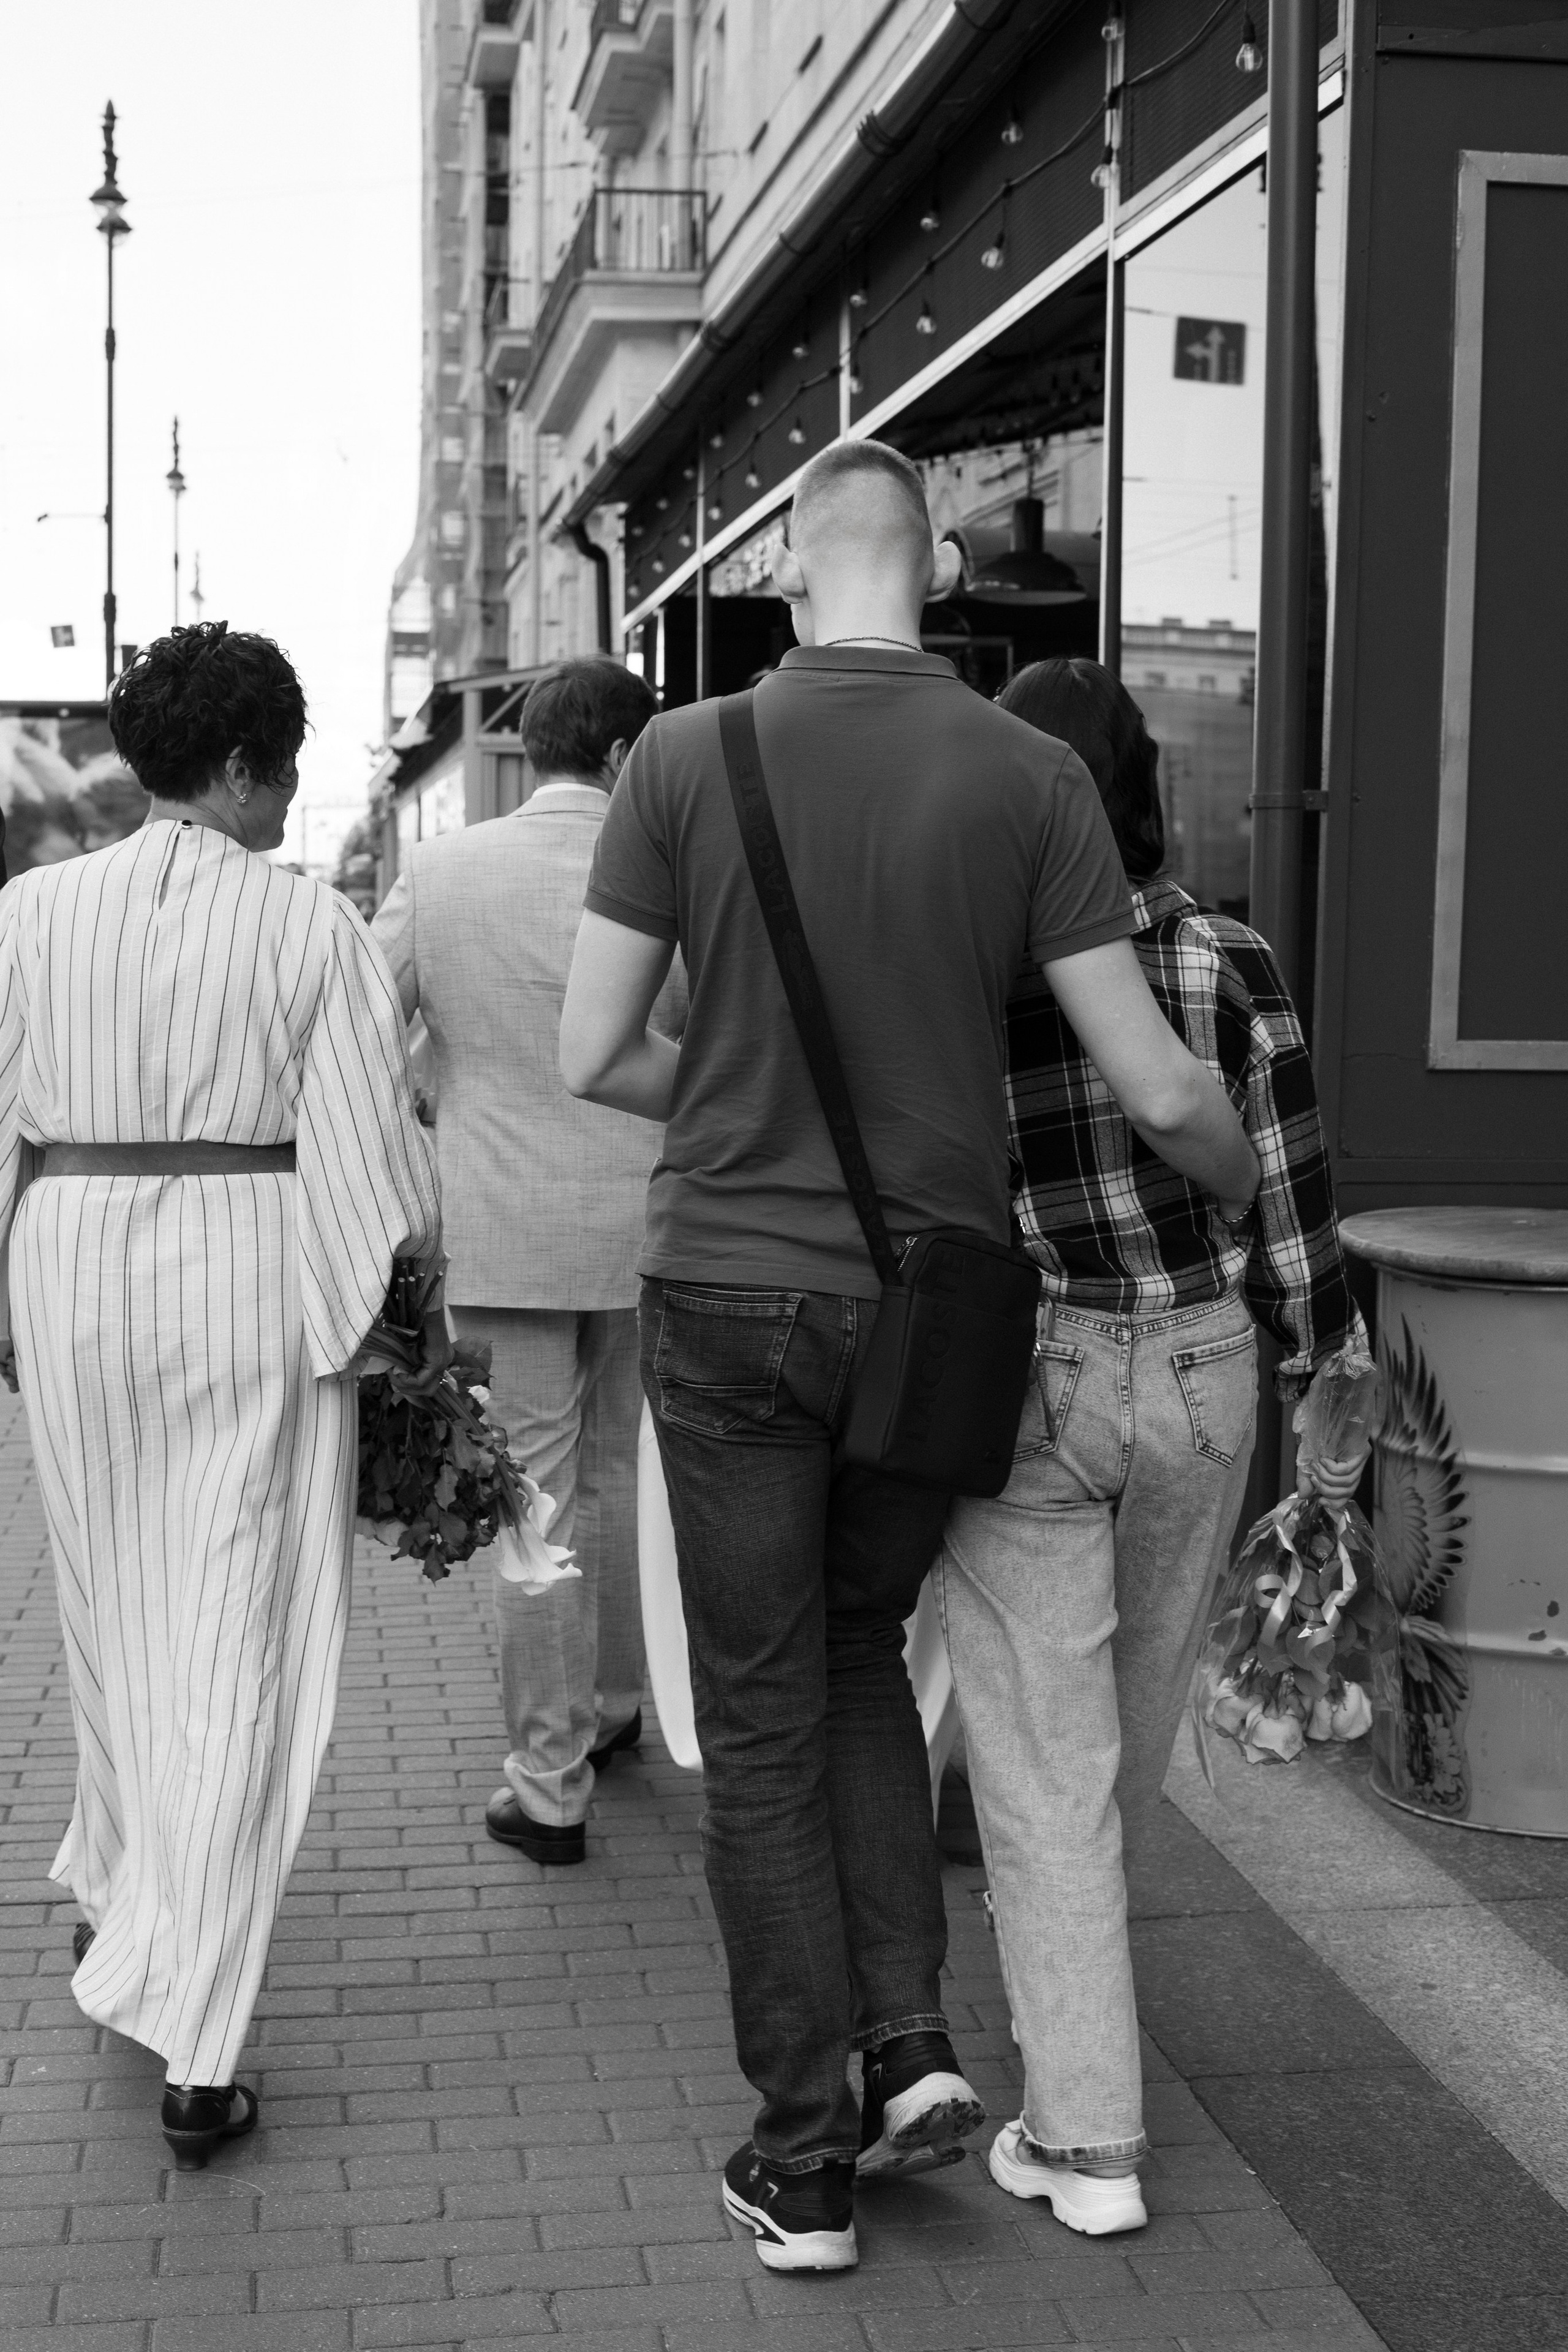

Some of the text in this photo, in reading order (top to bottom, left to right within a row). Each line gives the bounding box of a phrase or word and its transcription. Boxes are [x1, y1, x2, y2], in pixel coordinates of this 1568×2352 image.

[736, 761, 790, 914] LACOSTE
[832, 1109, 886, 1256] LACOSTE
[905, 1252, 965, 1442] LACOSTE
